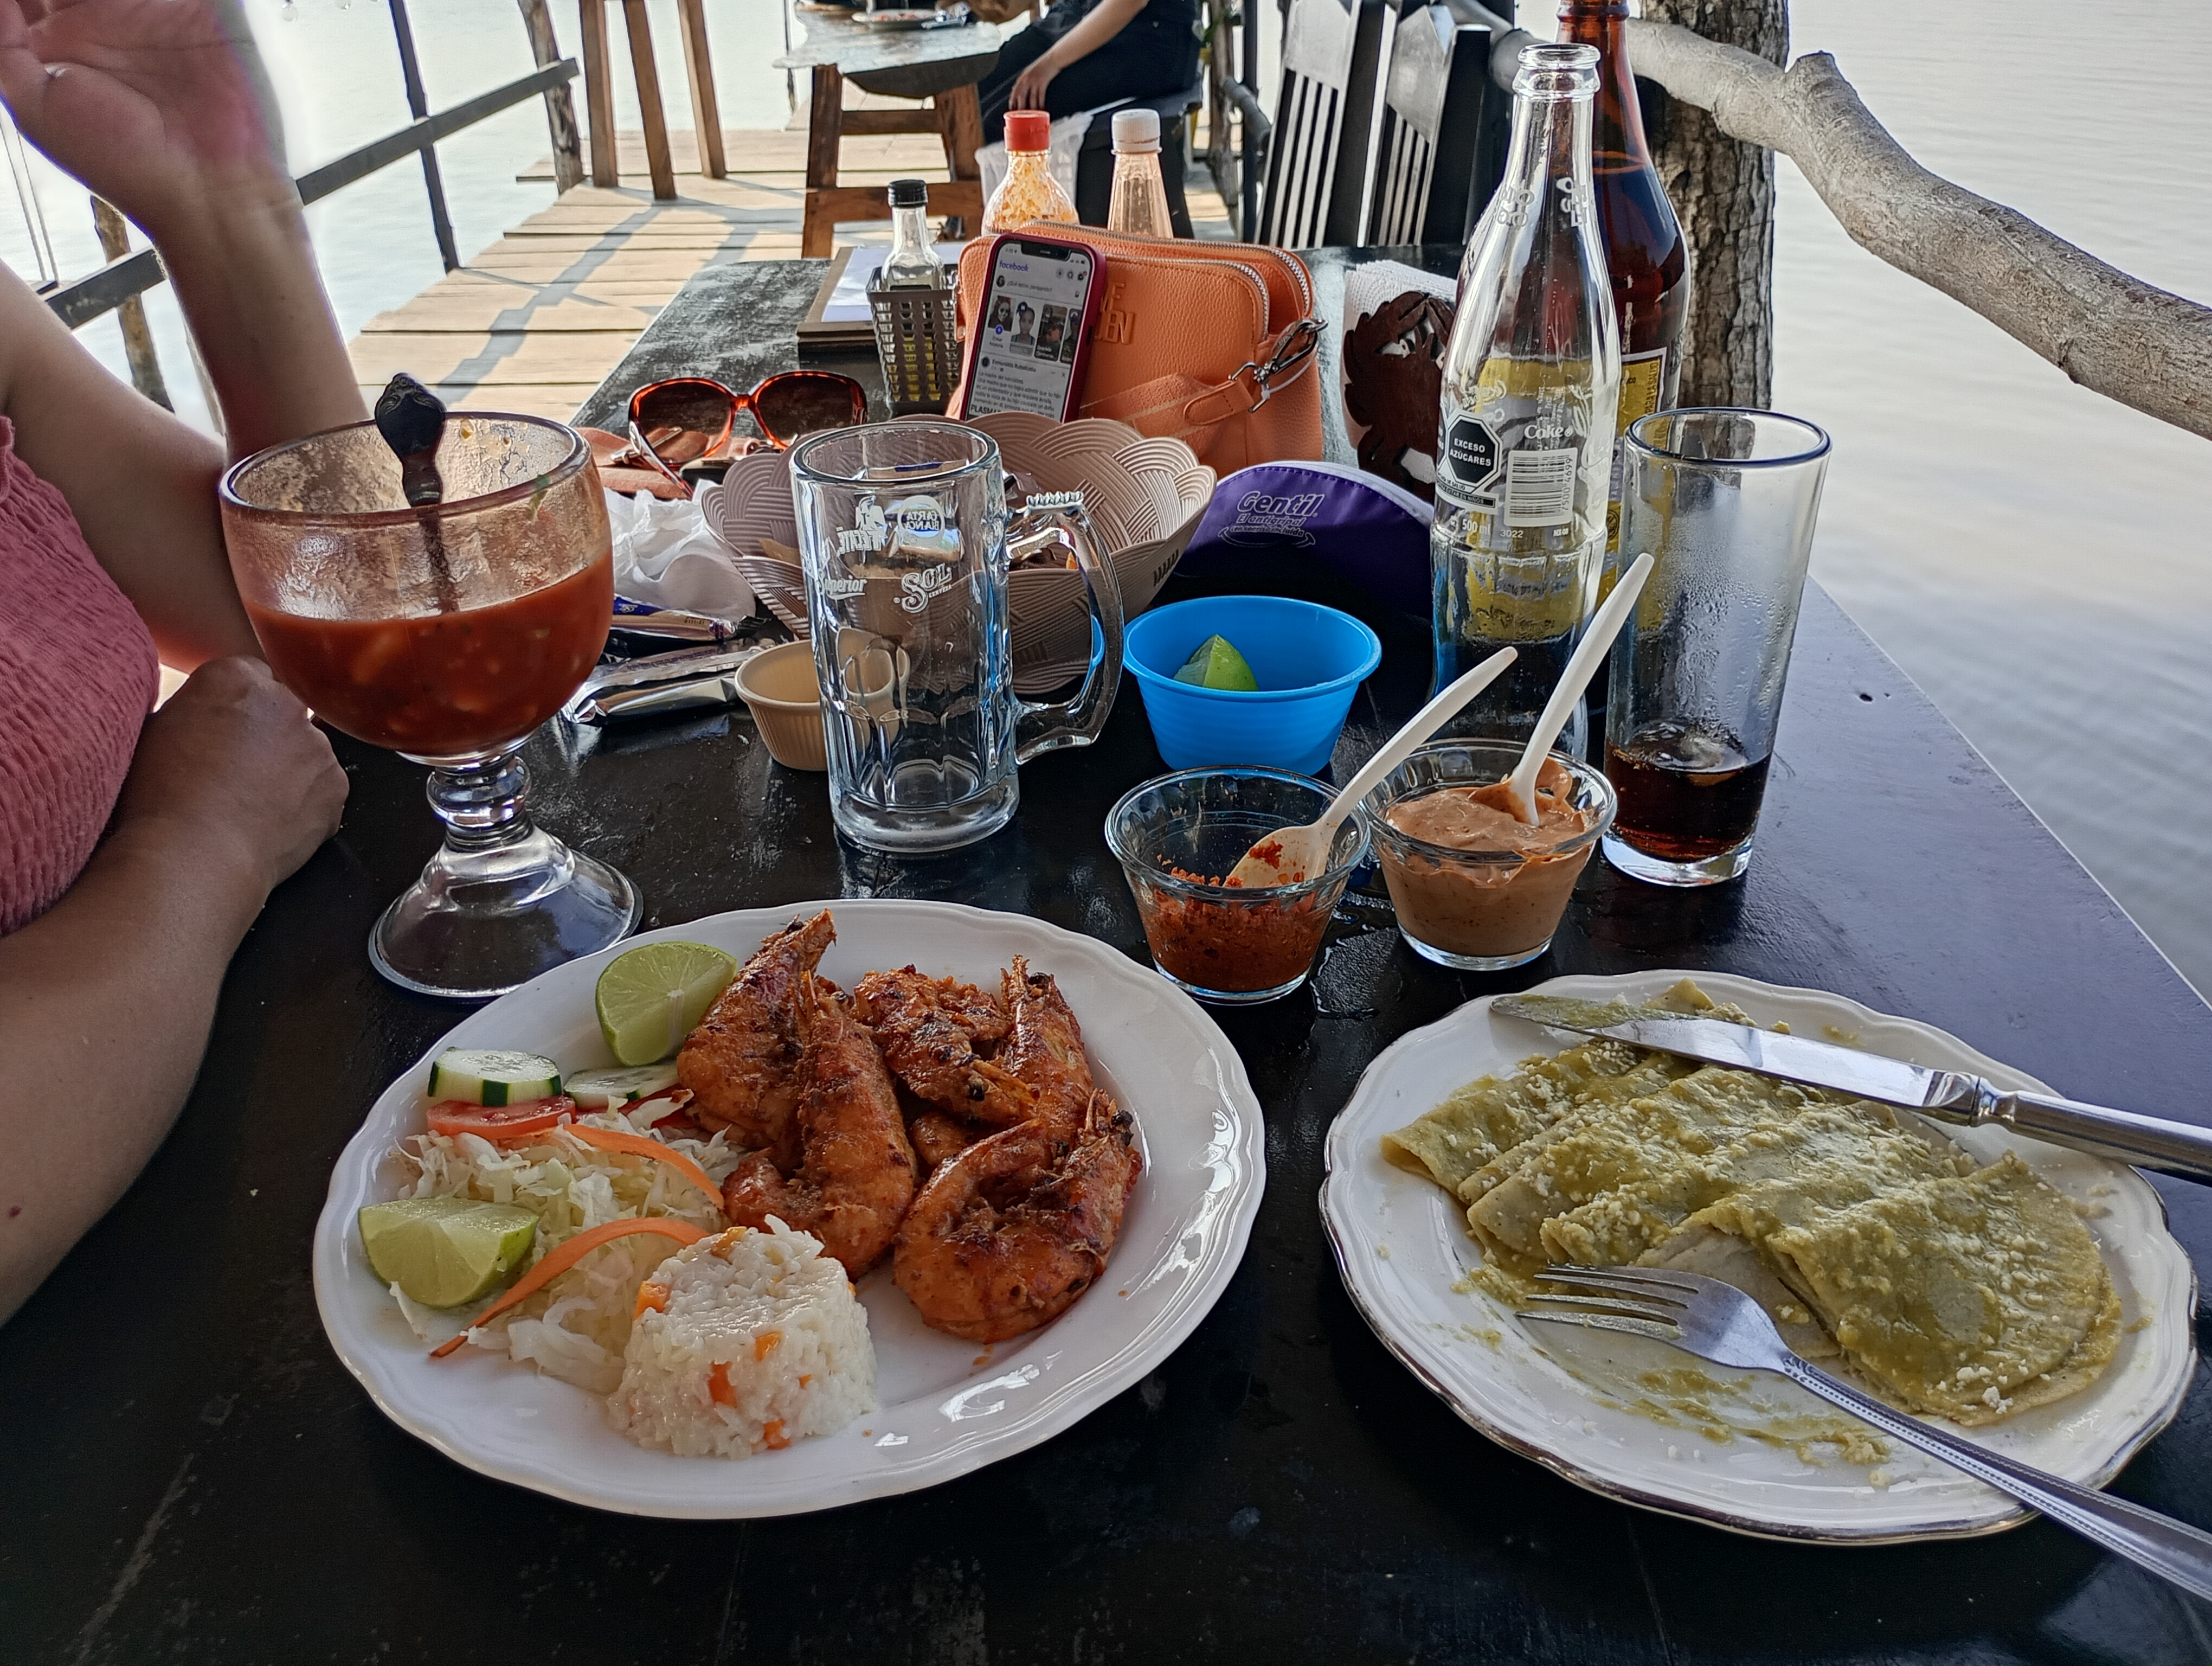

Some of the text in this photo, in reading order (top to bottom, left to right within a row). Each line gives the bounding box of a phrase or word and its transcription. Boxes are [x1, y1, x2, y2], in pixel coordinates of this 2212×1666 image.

[999, 260, 1029, 272] facebook
[1645, 362, 1658, 414] PARA LA SALUD
[1454, 438, 1486, 453] EXCESO
[1449, 449, 1491, 466] AZÚCARES
[1237, 491, 1325, 517] Gentil
[1236, 513, 1307, 527] El antigripal
[1462, 518, 1491, 535] 500 ml
[1500, 530, 1524, 539] 3022
[816, 569, 868, 596] Superior
[901, 562, 953, 613] SOL
